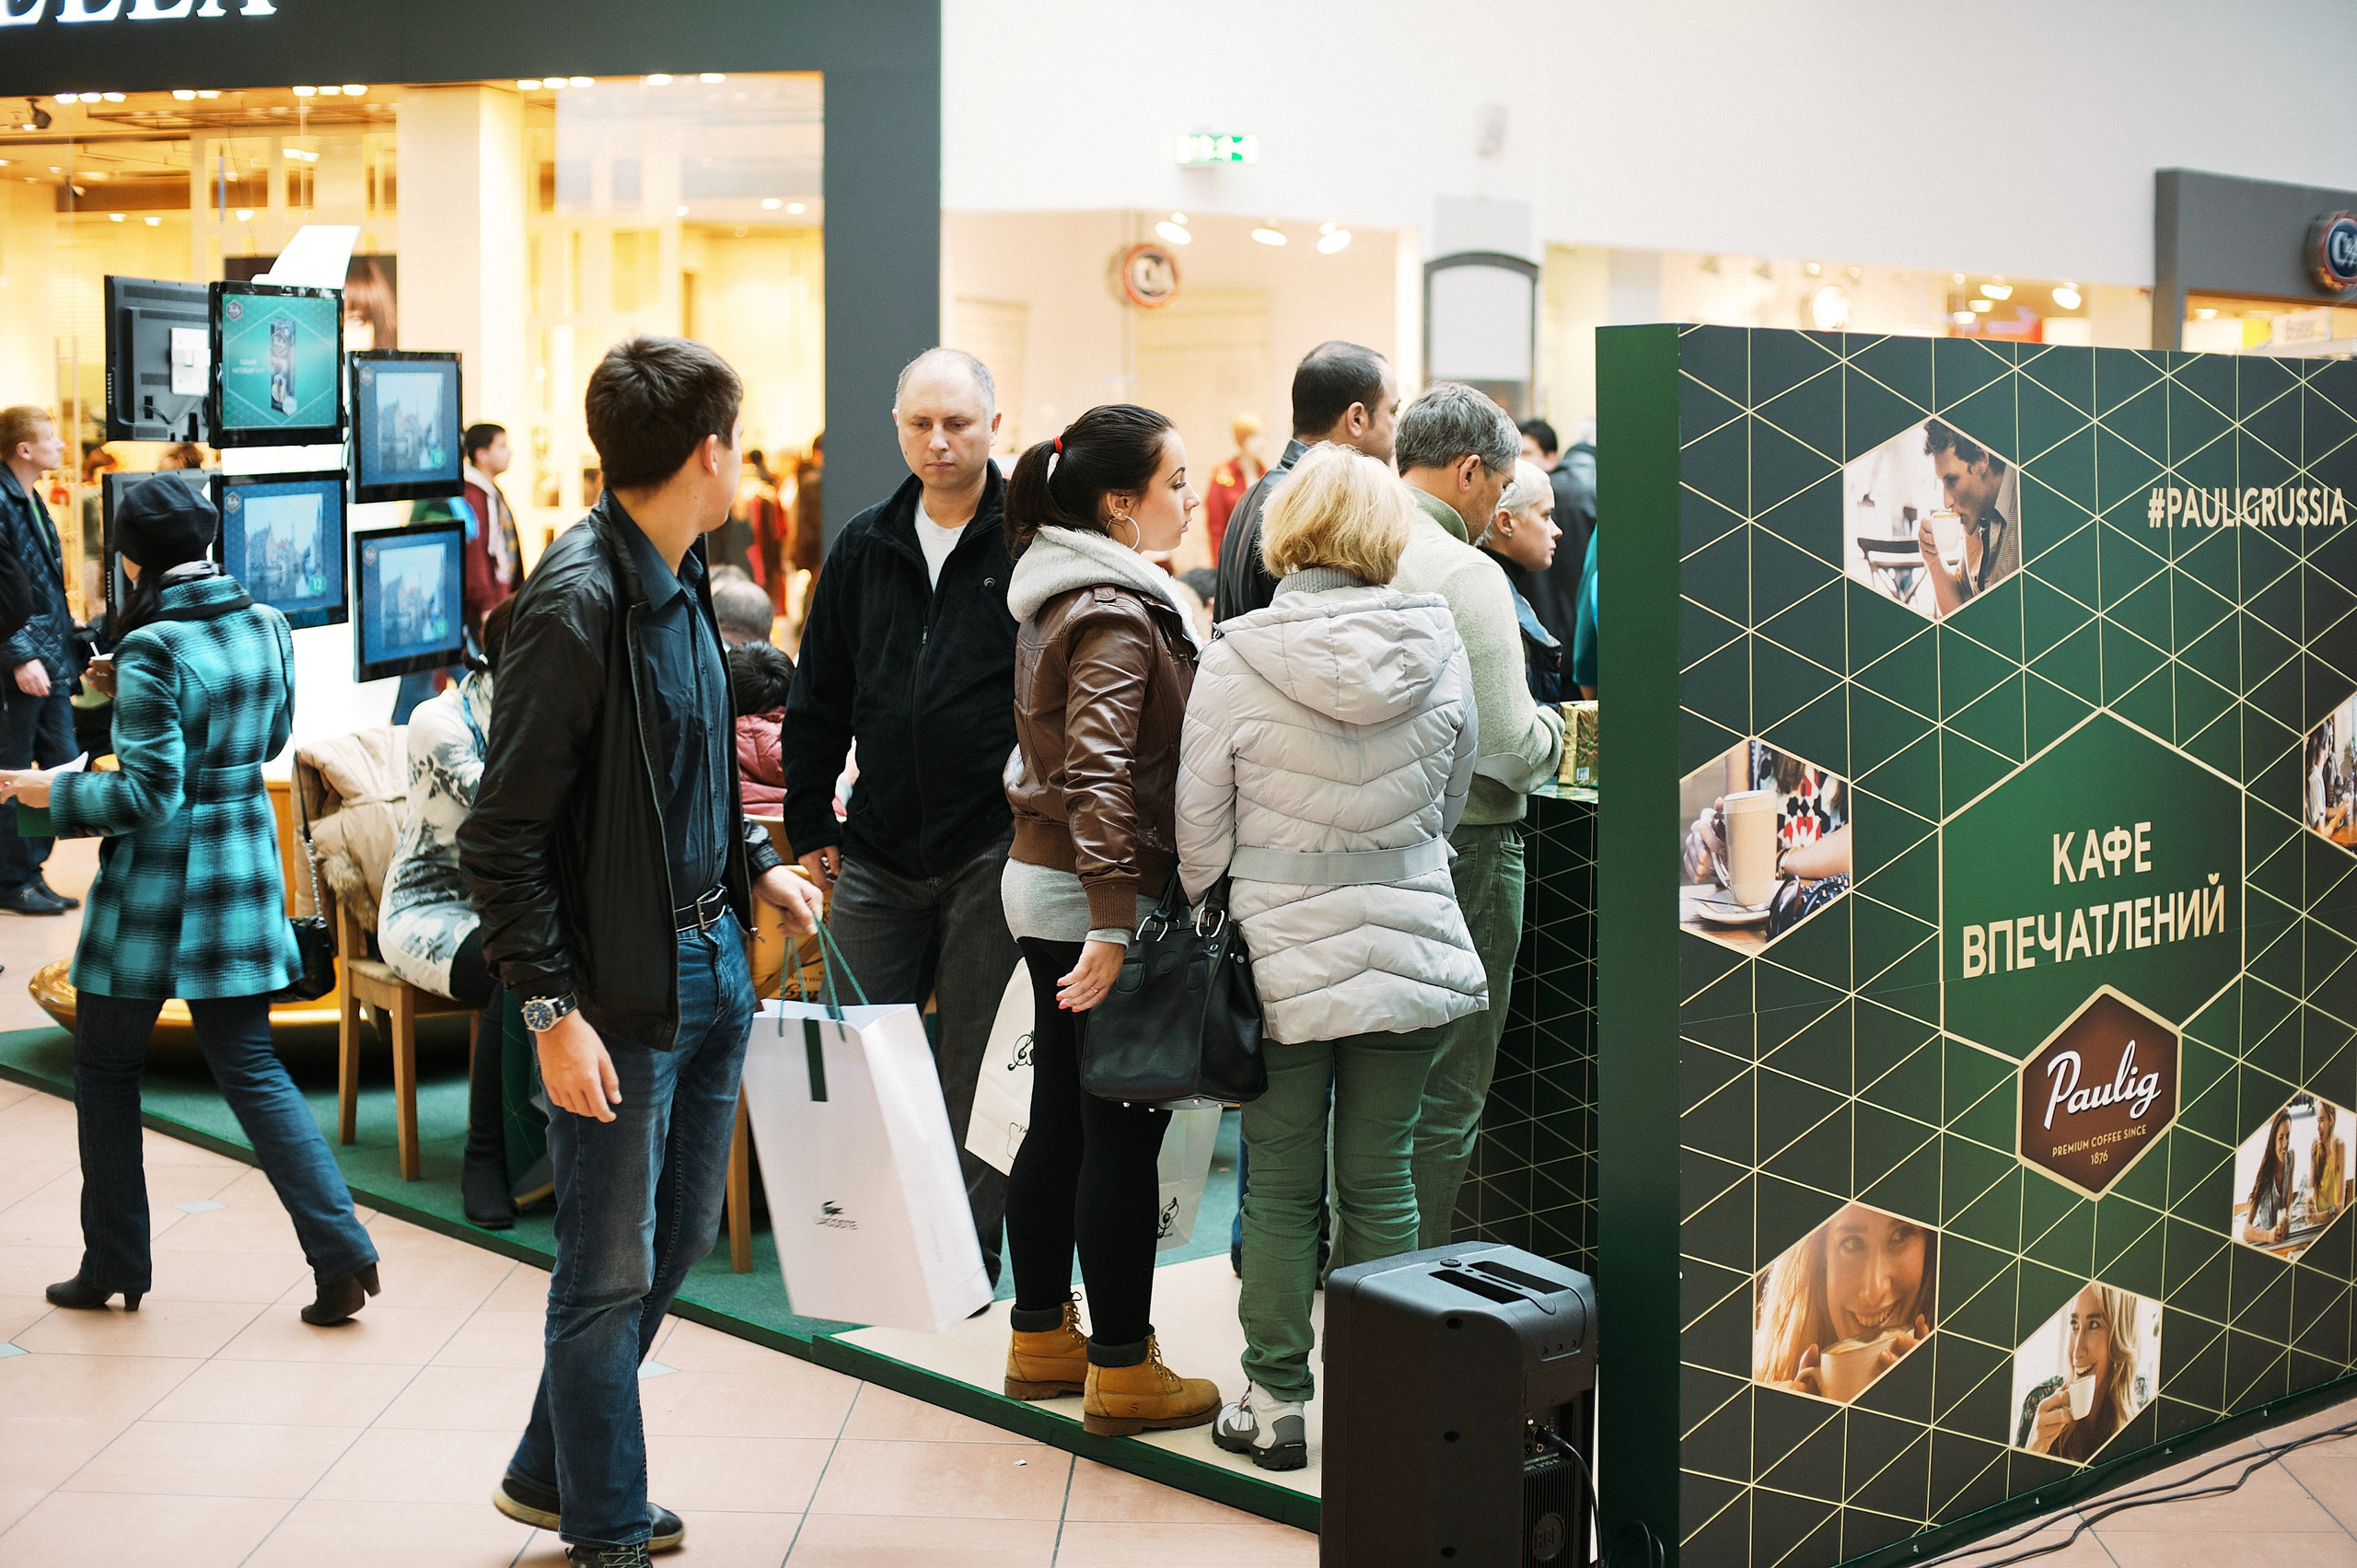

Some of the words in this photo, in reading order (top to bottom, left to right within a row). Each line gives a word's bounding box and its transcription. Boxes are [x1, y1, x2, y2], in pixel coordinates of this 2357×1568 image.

[2147, 487, 2348, 528] #PAULIGRUSSIA
[2052, 820, 2152, 886] КАФЕ
[1963, 872, 2224, 979] ВПЕЧАТЛЕНИЙ
[2043, 1039, 2162, 1131] Paulig
[2052, 1139, 2089, 1158] PREMIUM
[2091, 1131, 2122, 1147] COFFEE
[2123, 1123, 2147, 1140] SINCE
[2090, 1149, 2108, 1166] 1876
